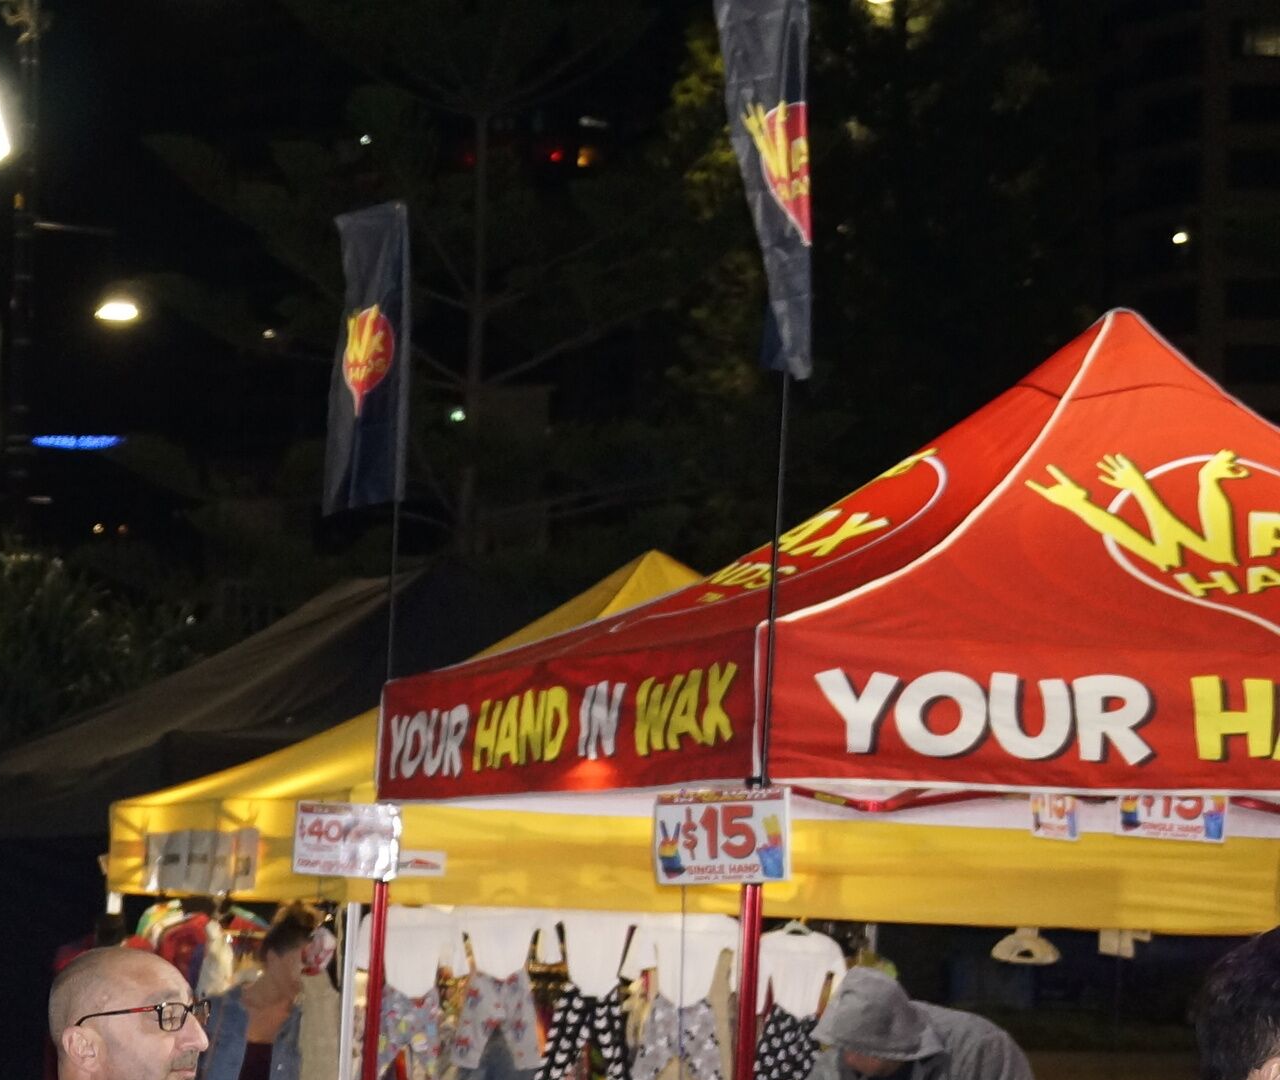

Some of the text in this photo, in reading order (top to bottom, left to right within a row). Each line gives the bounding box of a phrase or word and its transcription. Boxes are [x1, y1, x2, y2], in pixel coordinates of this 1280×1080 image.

[389, 661, 739, 781] YOUR HAND IN WAX
[813, 667, 1157, 767] YOUR
[681, 804, 757, 861] $15
